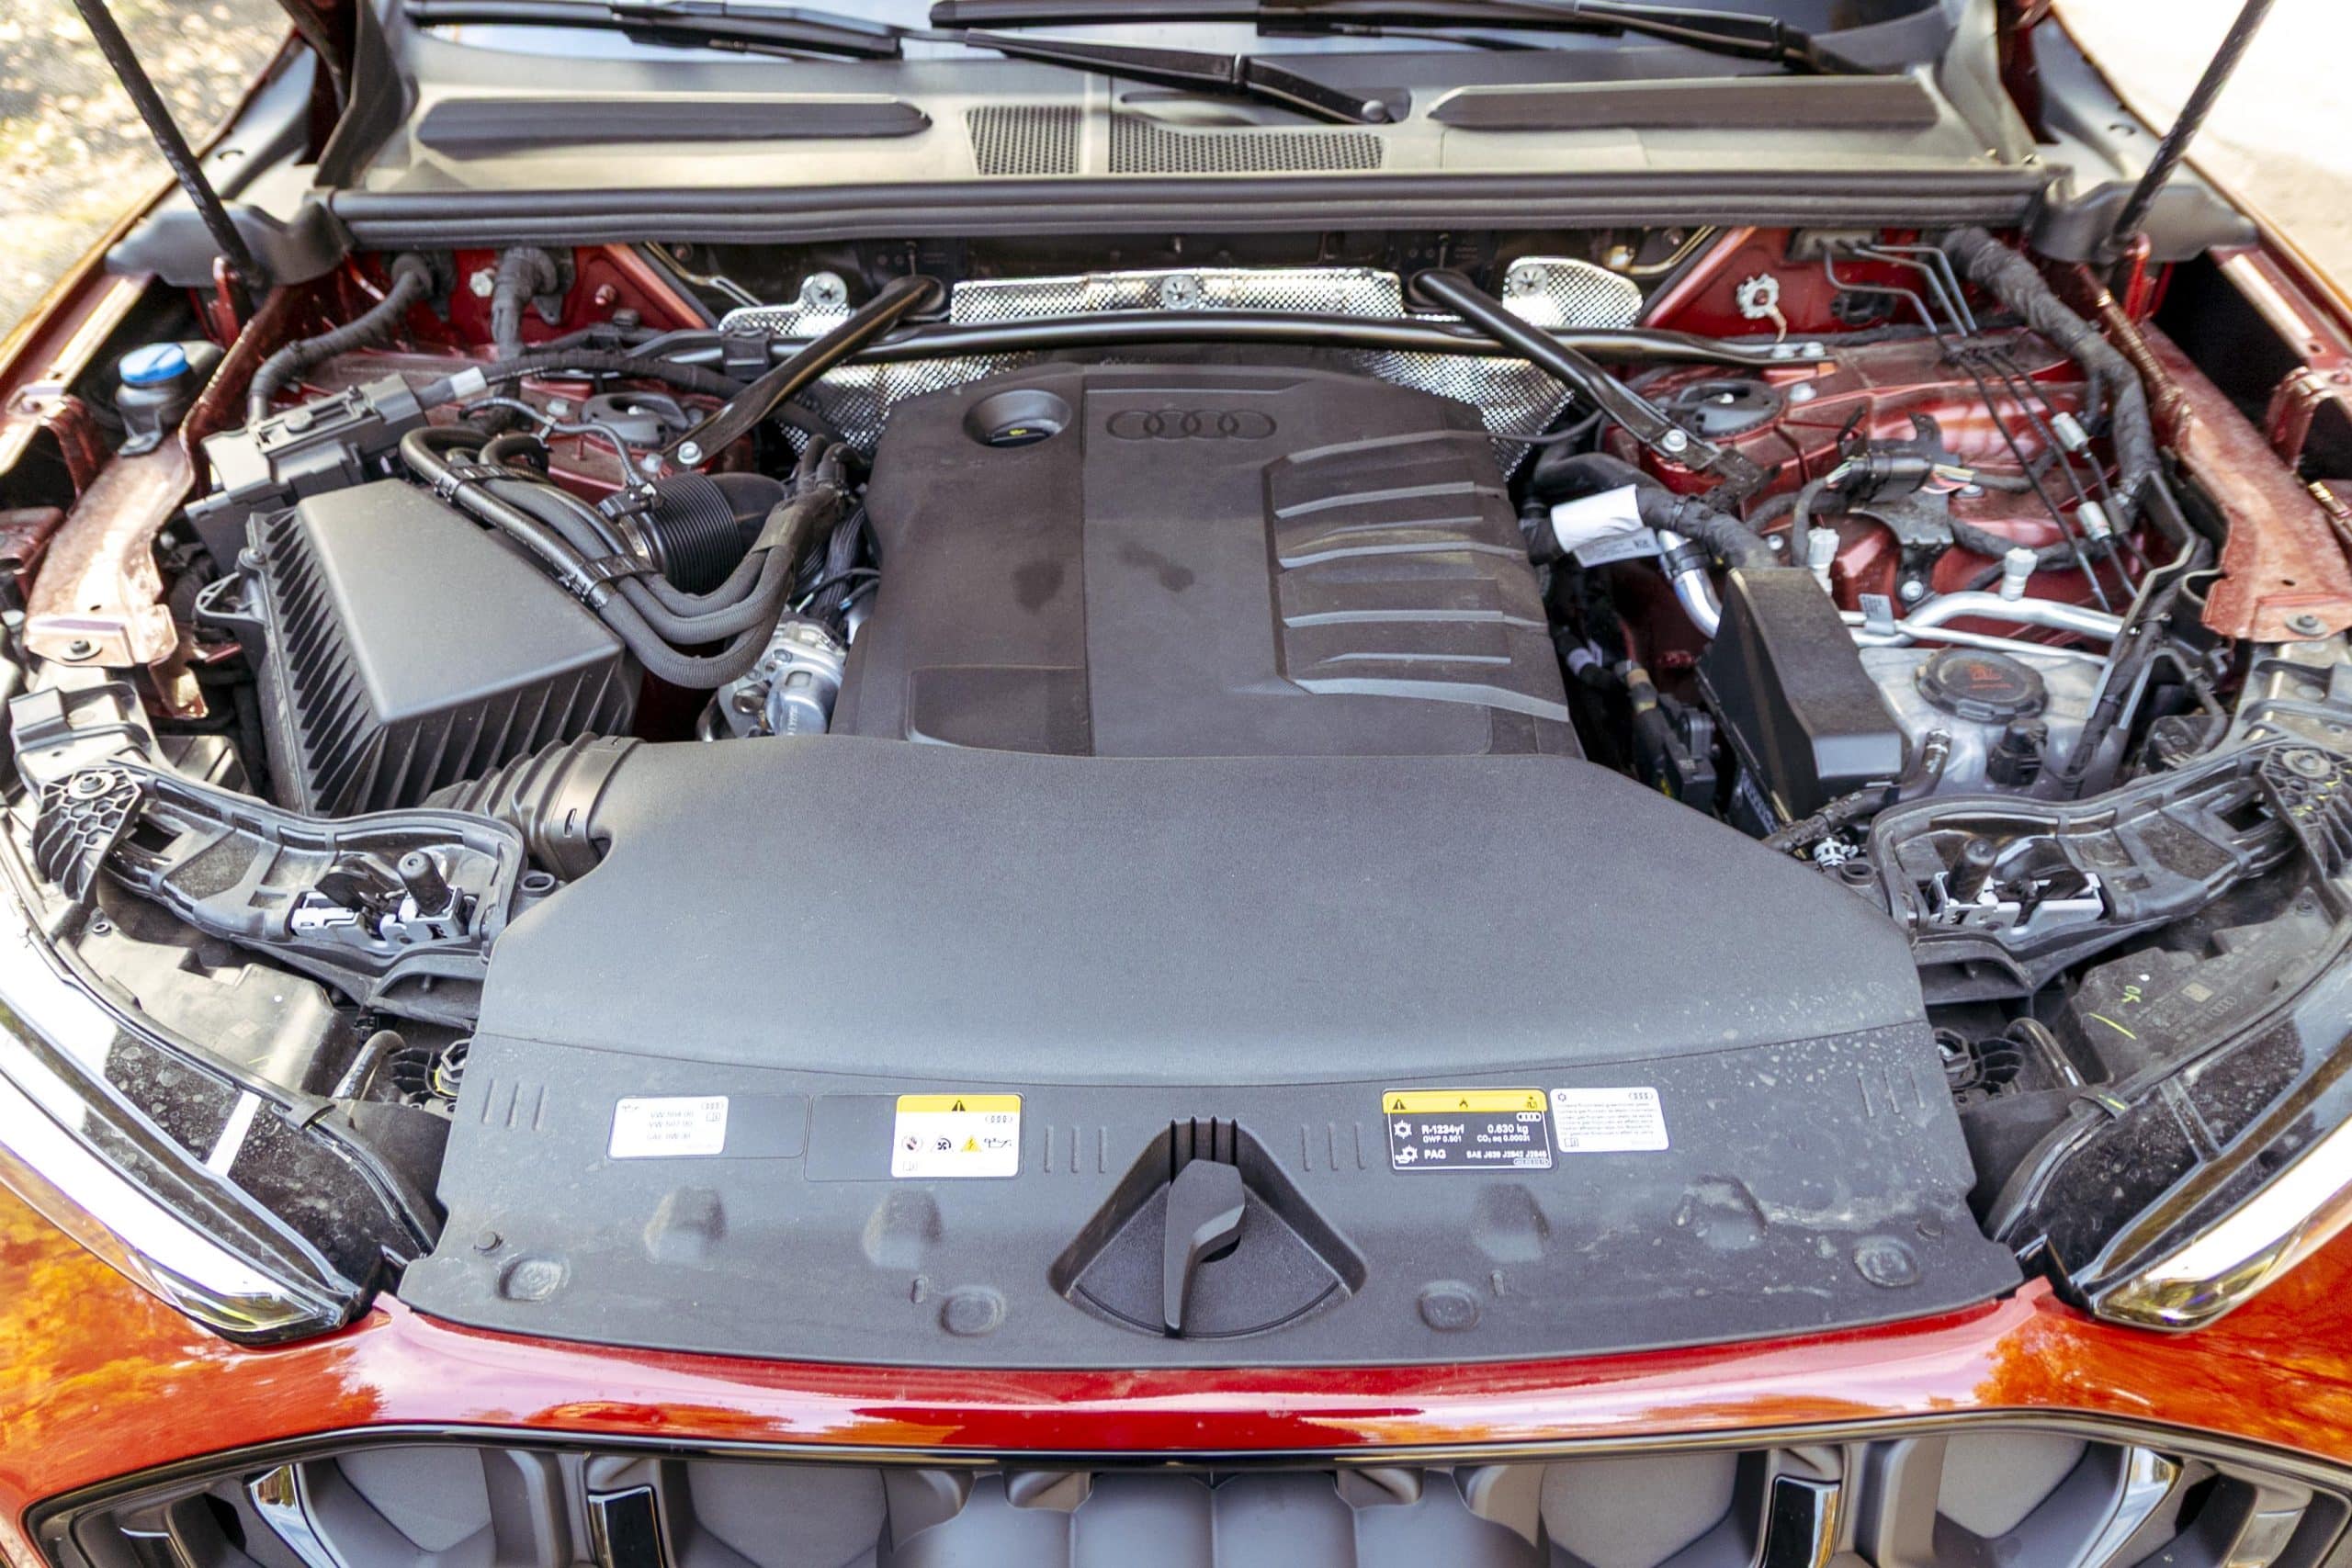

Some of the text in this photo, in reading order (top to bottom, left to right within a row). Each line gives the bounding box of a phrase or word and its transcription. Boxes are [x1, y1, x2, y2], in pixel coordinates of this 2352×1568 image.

[1421, 1123, 1464, 1135] R-1234yf
[1517, 1123, 1529, 1134] kg
[1424, 1149, 1446, 1159] PAG
[1466, 1150, 1483, 1159] SAE
